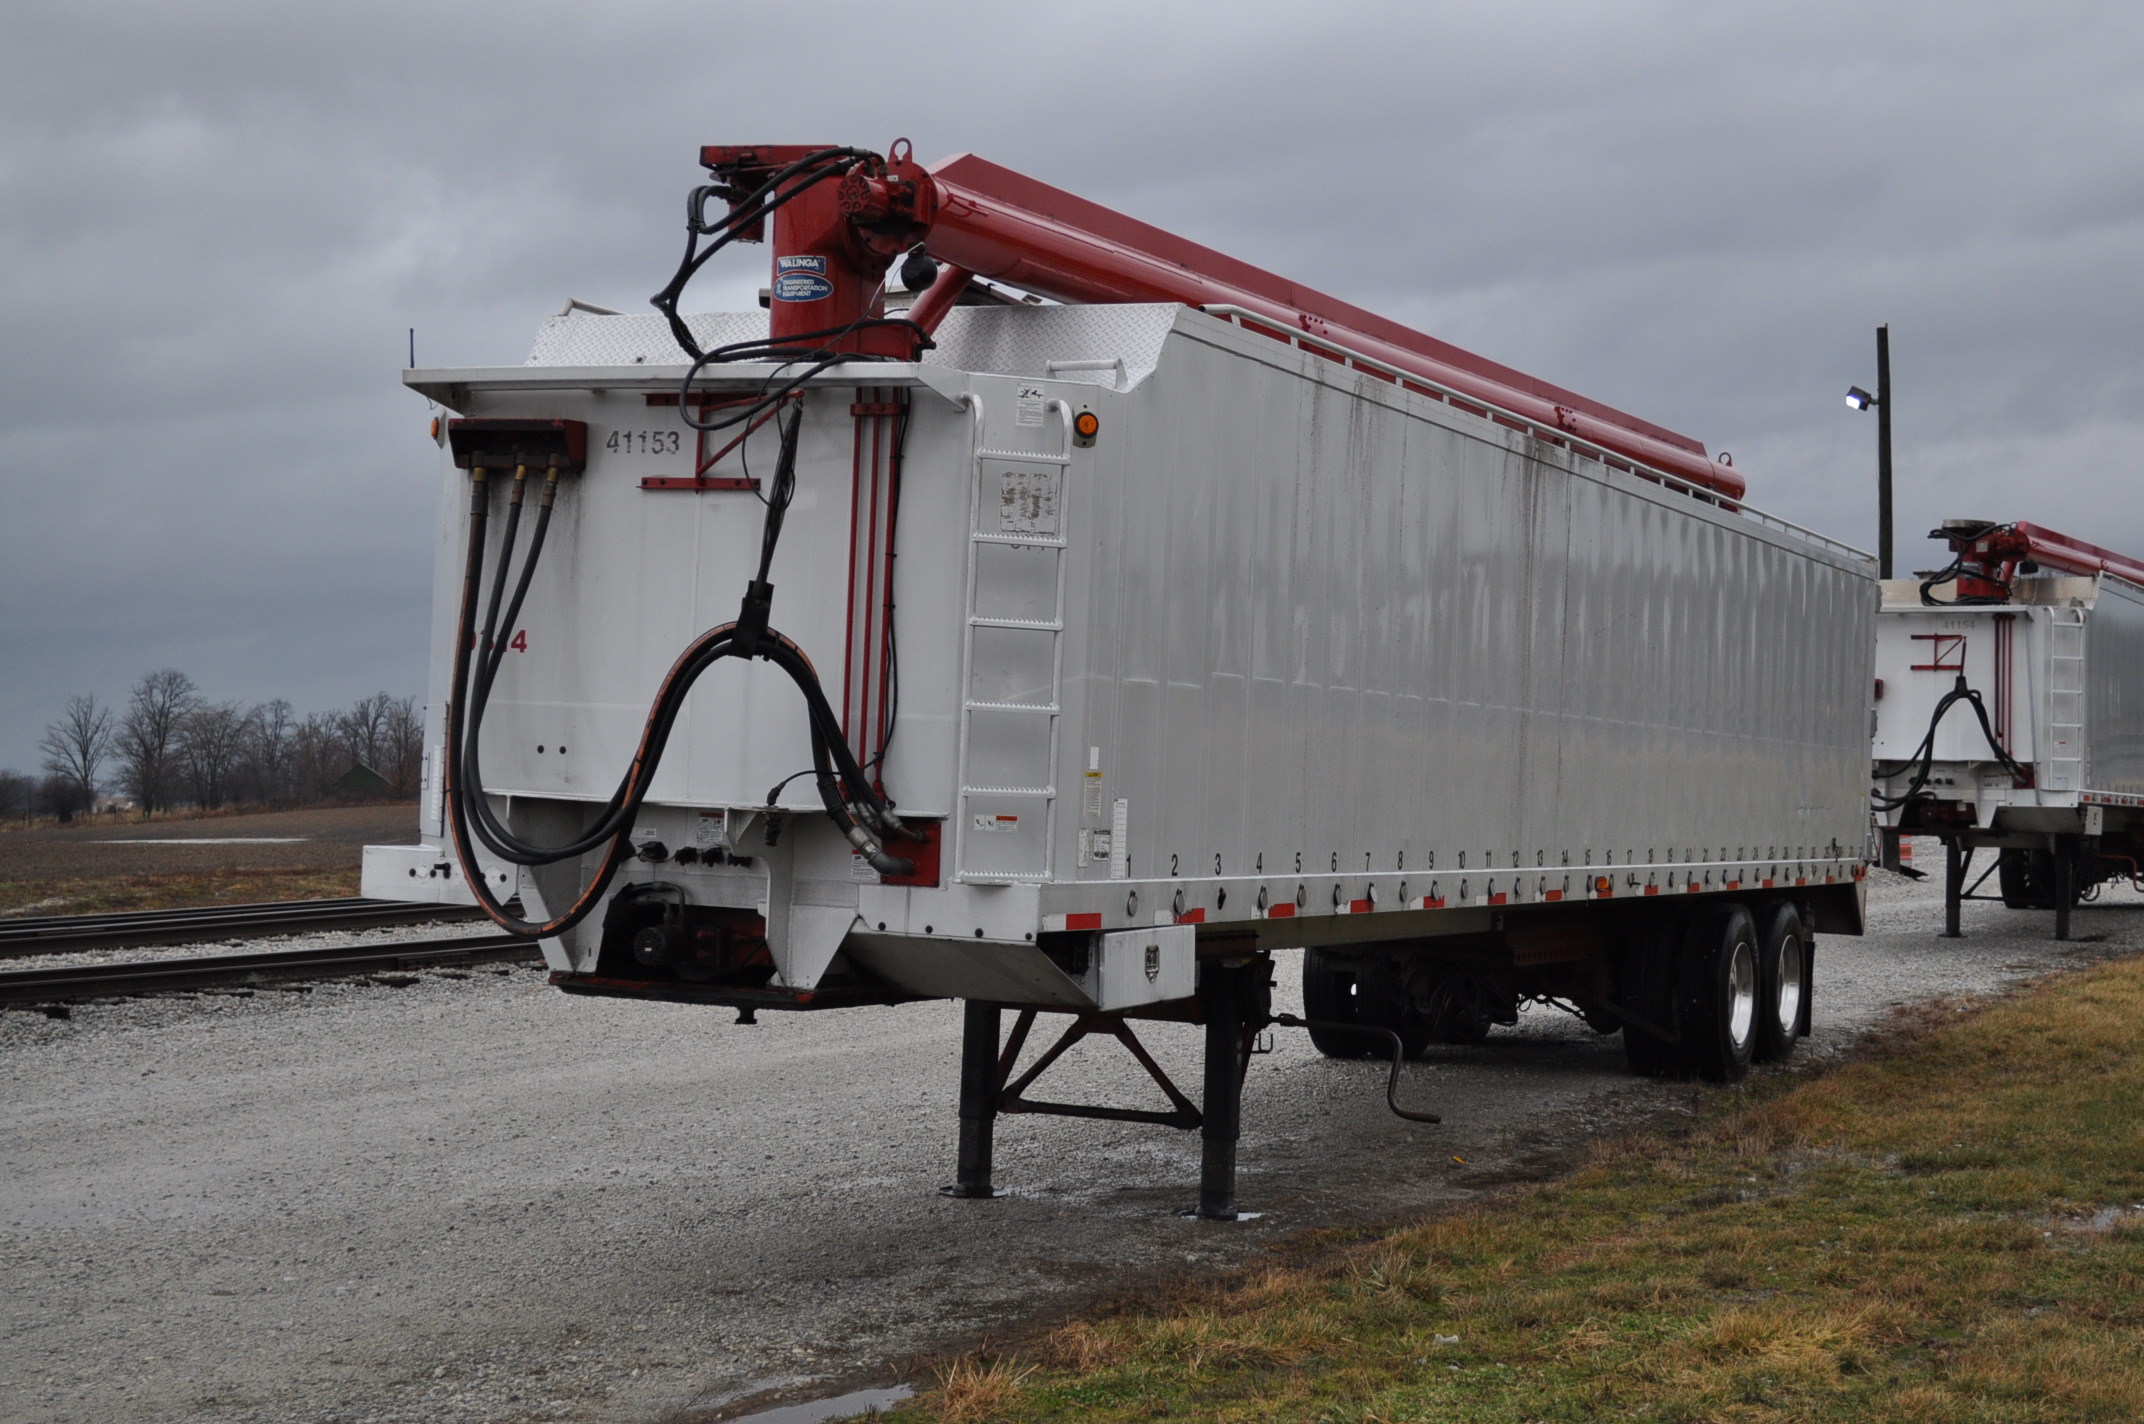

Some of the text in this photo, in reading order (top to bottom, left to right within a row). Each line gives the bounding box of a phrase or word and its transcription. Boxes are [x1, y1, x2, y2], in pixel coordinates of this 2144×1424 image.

[780, 258, 819, 268] WALINGA
[782, 284, 828, 292] TRANSPORTATION
[606, 430, 680, 455] 41153
[1943, 620, 1975, 630] 41154
[1126, 854, 1131, 878] 1
[1171, 853, 1178, 877] 2
[1214, 852, 1222, 876] 3
[1256, 852, 1263, 874] 4
[1295, 851, 1302, 874] 5
[1331, 851, 1338, 873] 6
[1365, 852, 1371, 873] 7
[1397, 850, 1404, 871] 8
[1428, 850, 1435, 870] 9
[1458, 850, 1466, 869] 10
[1485, 849, 1492, 868] 11
[1512, 850, 1519, 868] 12
[1537, 849, 1544, 867] 13
[1561, 849, 1569, 866] 14
[1585, 849, 1592, 866] 15
[1606, 849, 1612, 866] 16
[1627, 849, 1633, 865] 17
[1648, 848, 1654, 864] 18
[1667, 848, 1674, 863] 19
